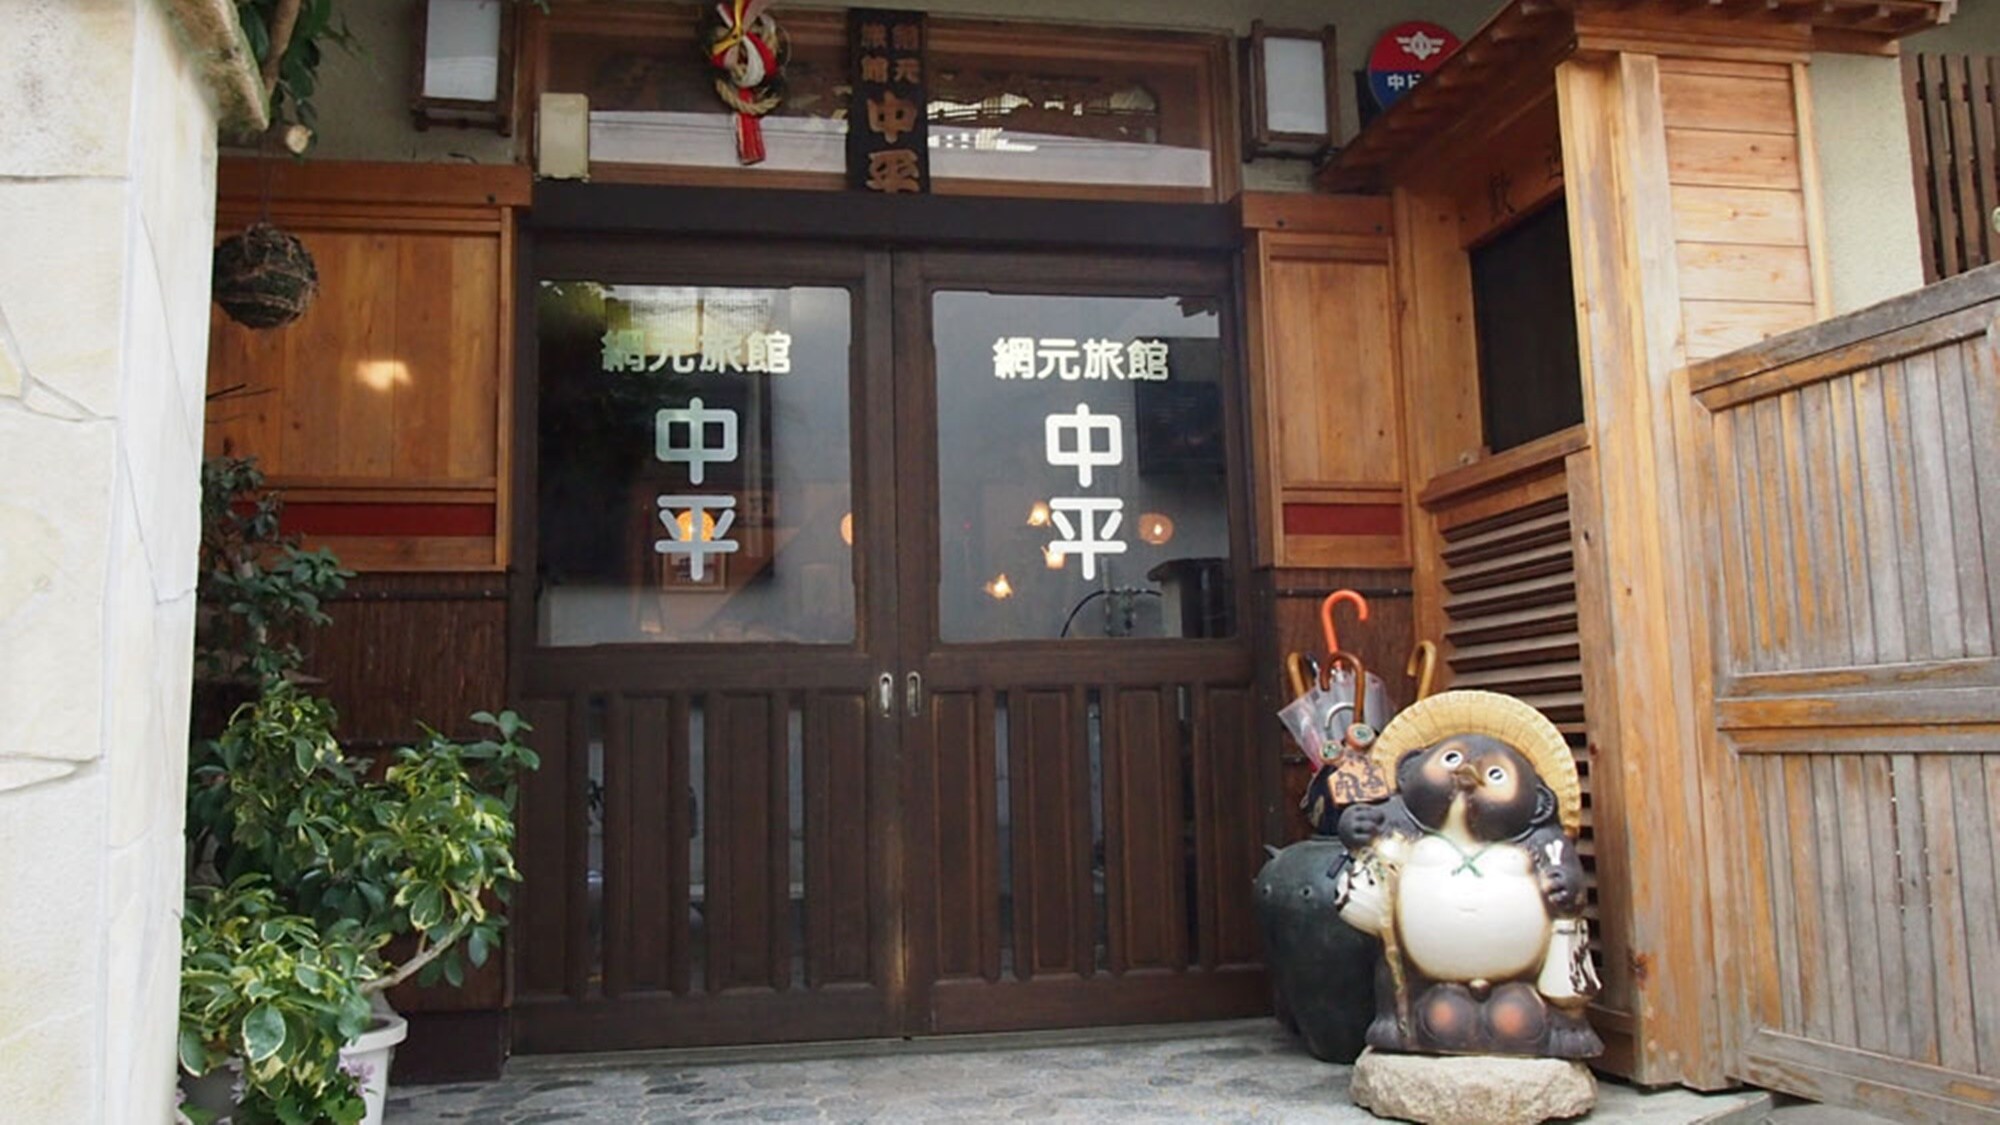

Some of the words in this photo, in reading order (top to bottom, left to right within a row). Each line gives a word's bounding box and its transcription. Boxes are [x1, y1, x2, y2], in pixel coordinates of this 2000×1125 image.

[601, 330, 791, 374] 網元旅館
[992, 337, 1169, 381] 網元旅館
[655, 397, 739, 581] 中平
[1045, 403, 1127, 581] 中平
